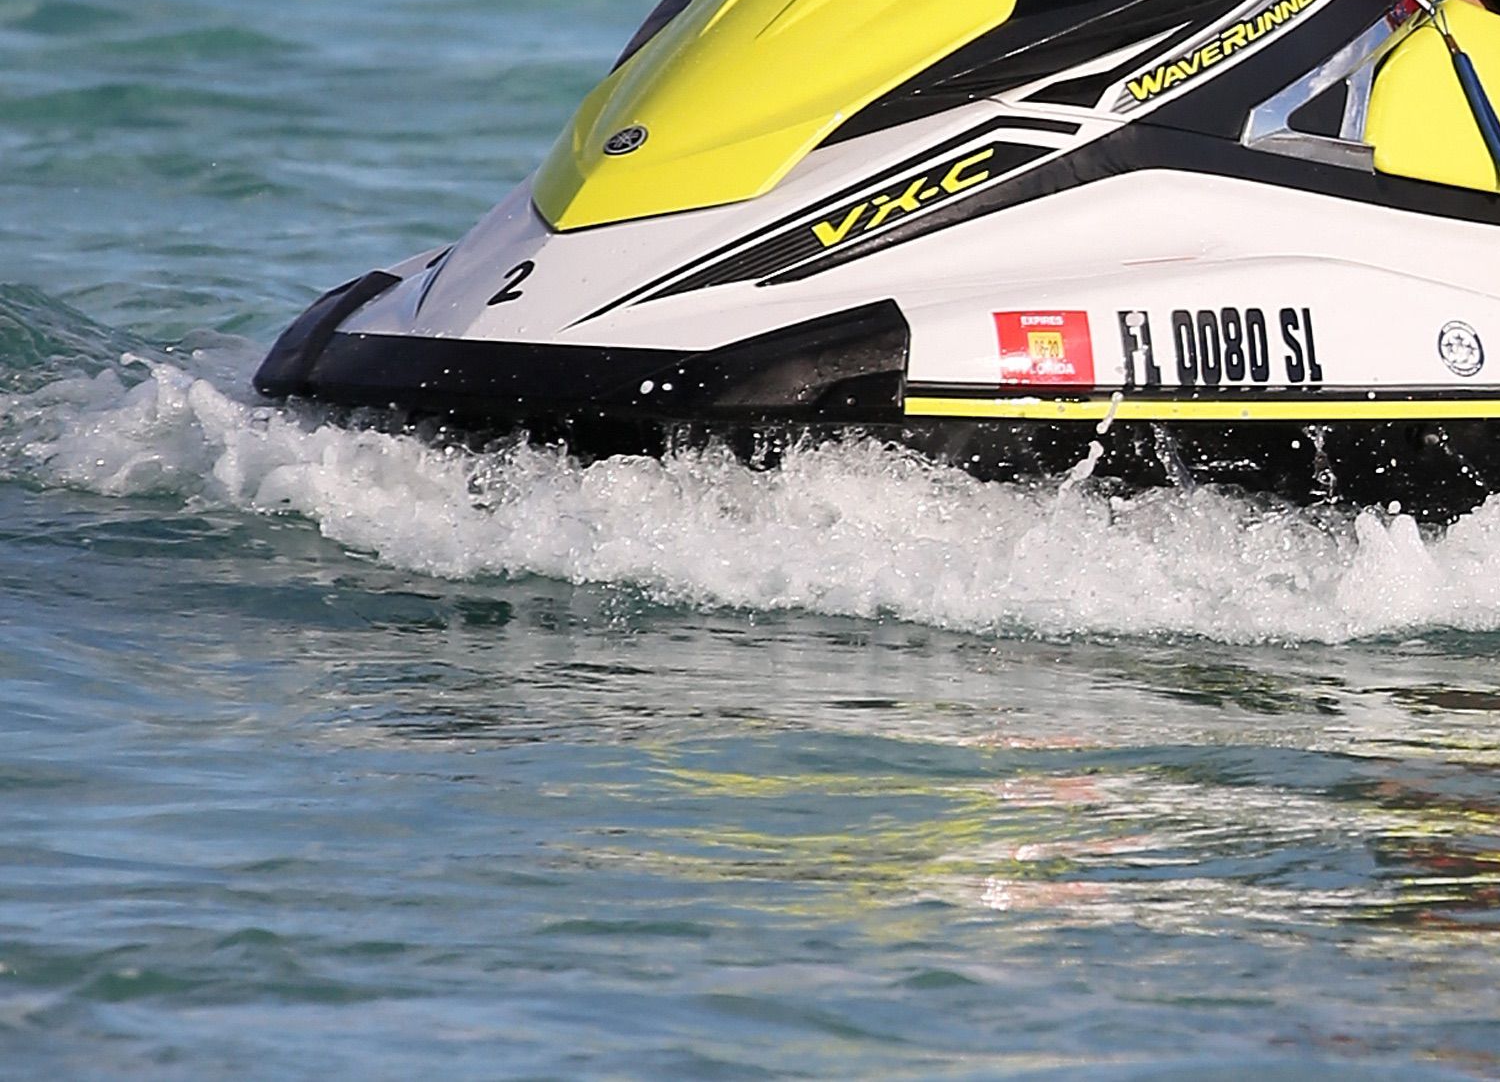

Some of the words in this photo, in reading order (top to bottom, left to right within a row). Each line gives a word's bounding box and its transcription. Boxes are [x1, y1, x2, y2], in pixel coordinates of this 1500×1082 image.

[811, 148, 995, 248] VX-C
[486, 260, 535, 306] 2
[1020, 315, 1065, 326] EXPIRES
[1117, 310, 1162, 386] FL
[1171, 307, 1270, 385] 0080
[1279, 307, 1323, 383] SL
